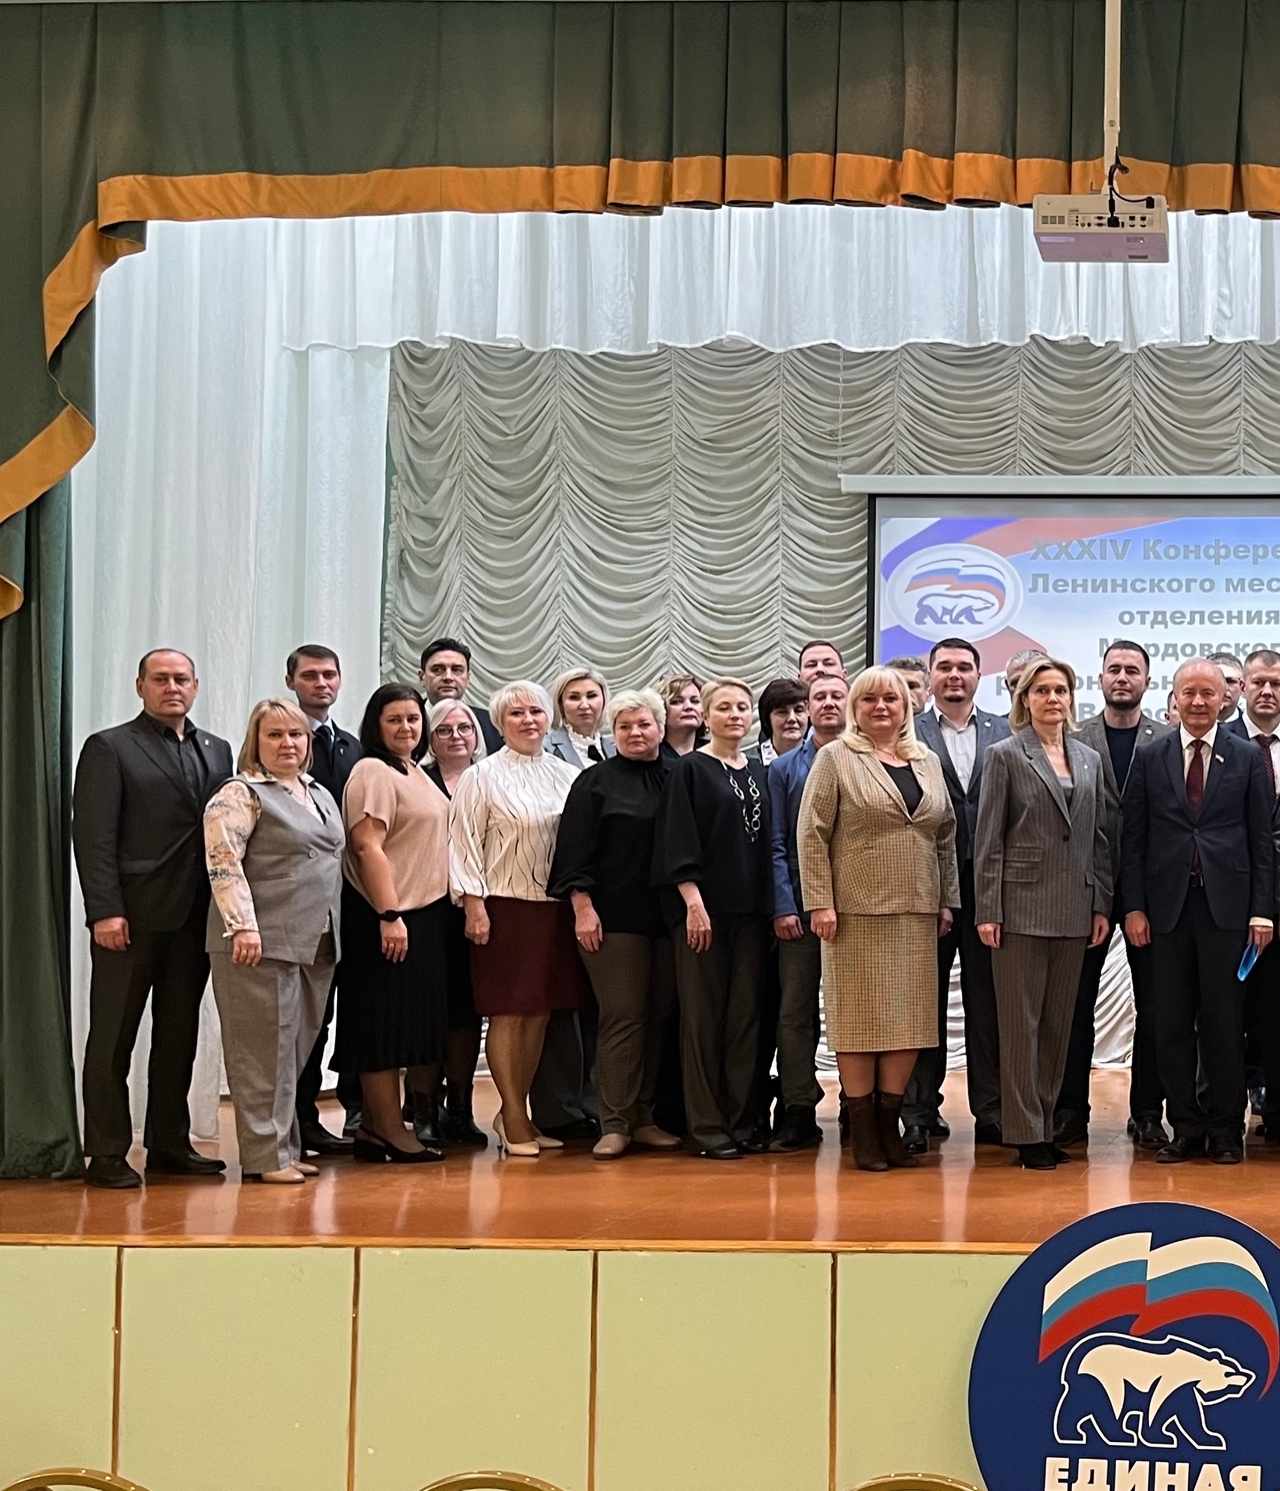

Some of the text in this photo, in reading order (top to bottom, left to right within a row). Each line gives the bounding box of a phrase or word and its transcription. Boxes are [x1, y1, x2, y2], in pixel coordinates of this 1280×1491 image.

[1030, 539, 1132, 560] XXXIV
[1028, 573, 1216, 593] Ленинского
[1118, 610, 1280, 629] отделения
[1044, 1457, 1262, 1491] ЕДИНАЯ
